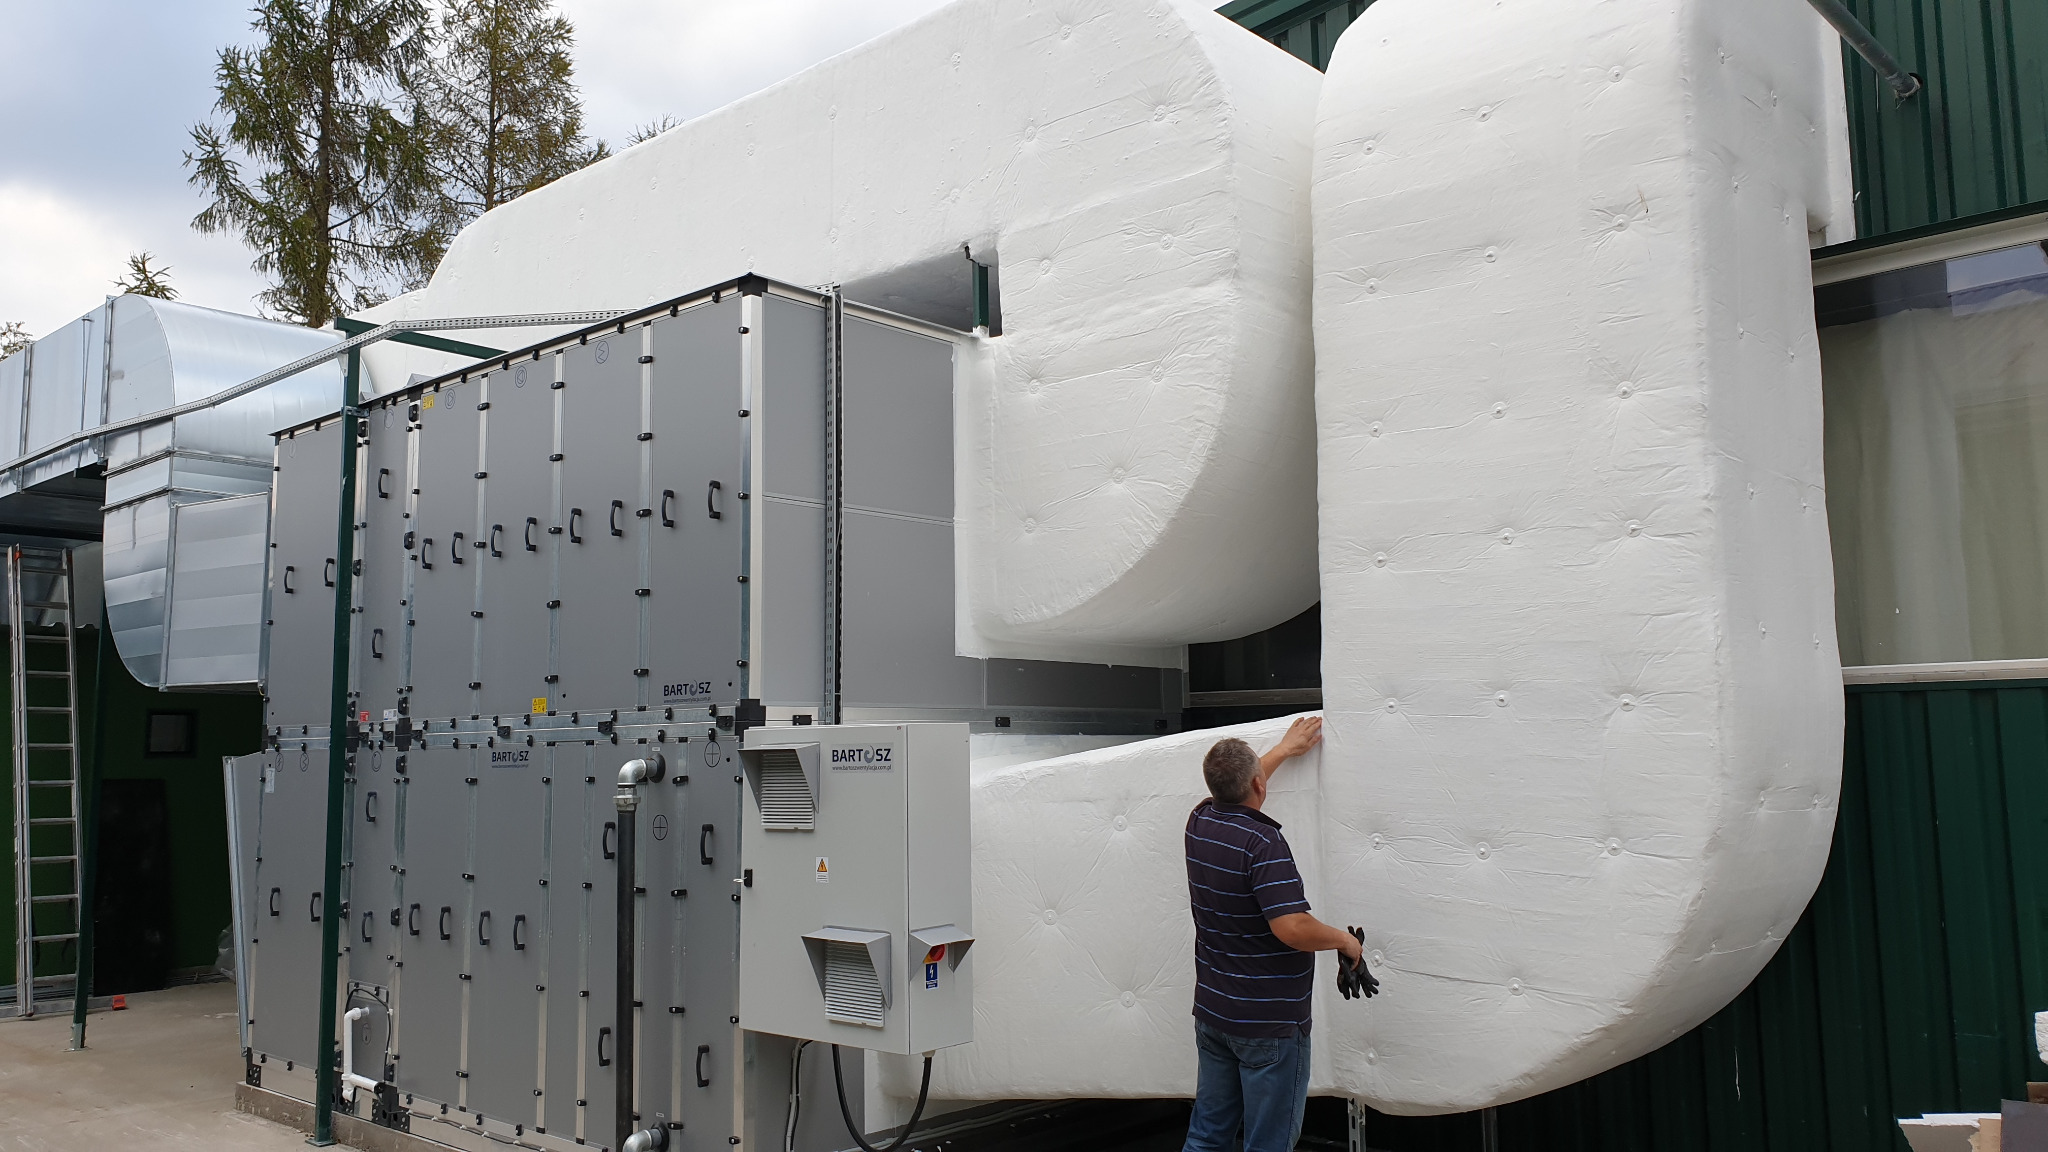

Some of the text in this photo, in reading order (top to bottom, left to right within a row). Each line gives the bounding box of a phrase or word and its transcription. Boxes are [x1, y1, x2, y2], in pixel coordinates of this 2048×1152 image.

[664, 680, 711, 696] BARTOSZ
[491, 749, 529, 763] BARTOSZ
[832, 745, 892, 763] BARTOSZ
